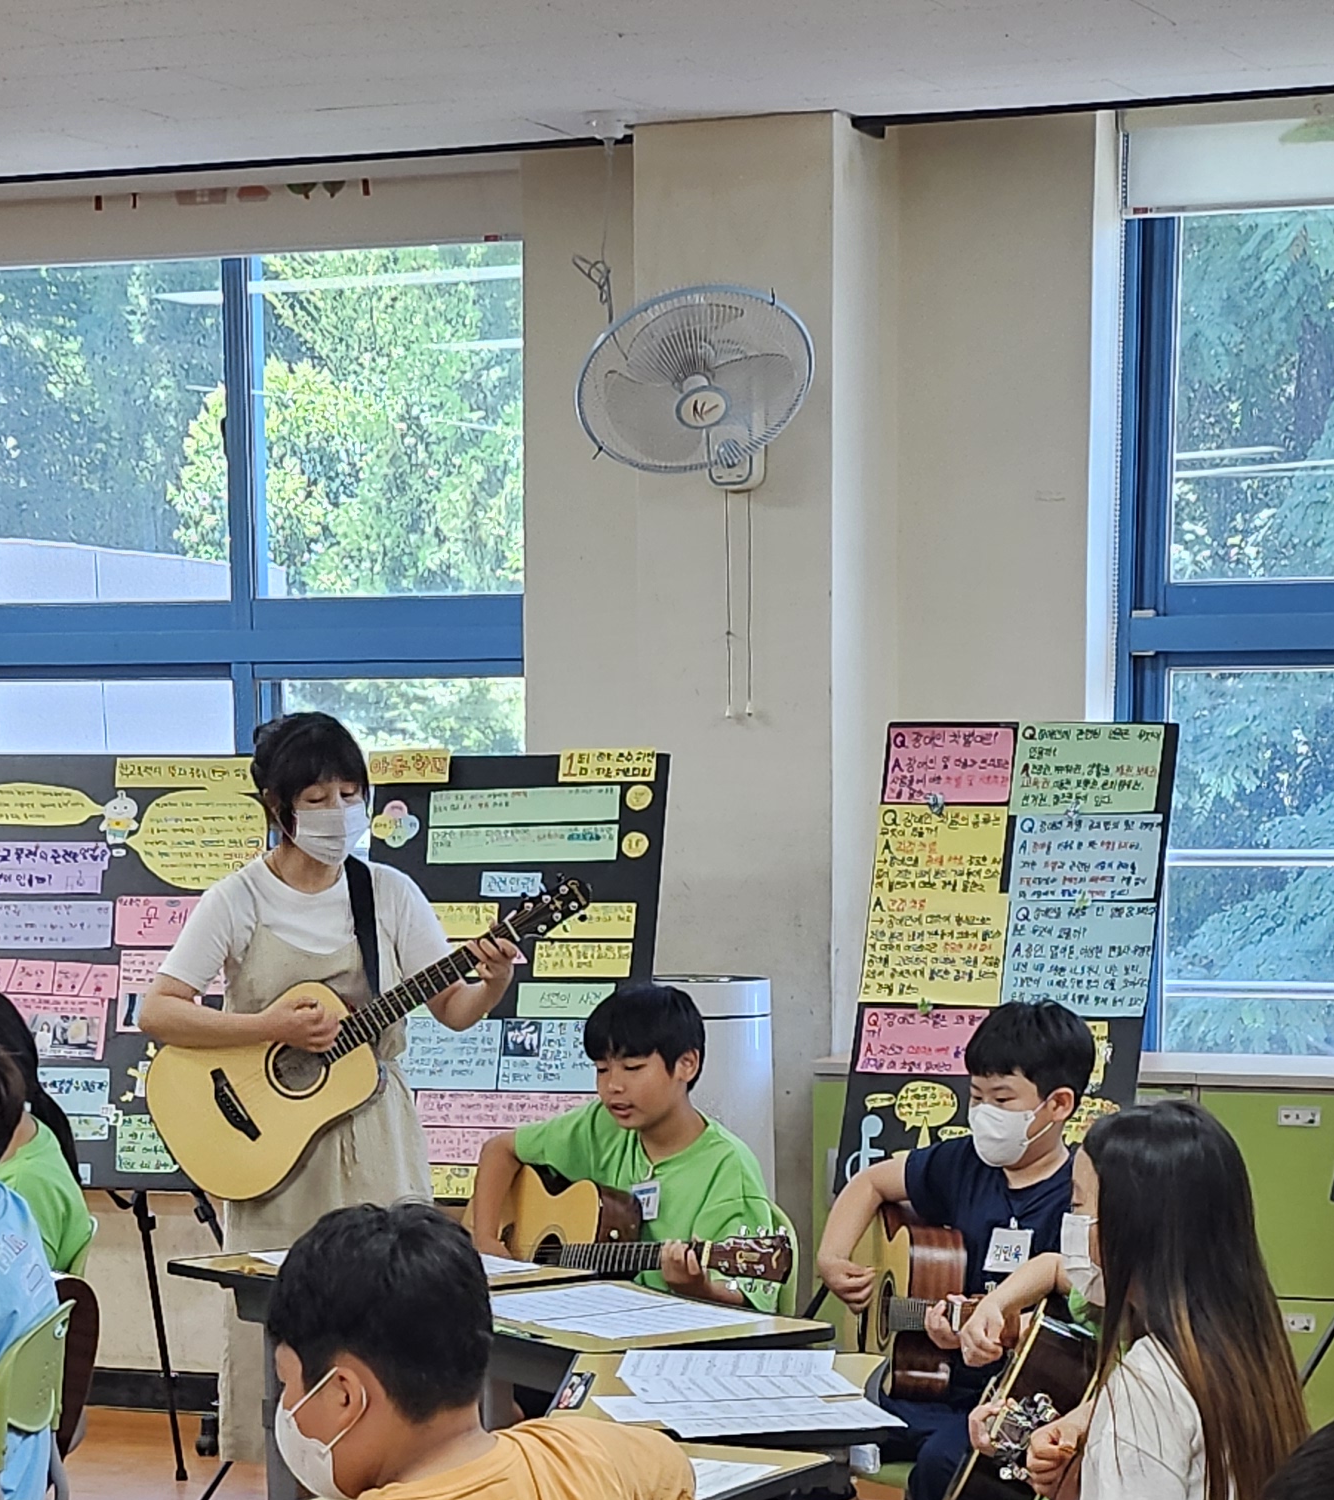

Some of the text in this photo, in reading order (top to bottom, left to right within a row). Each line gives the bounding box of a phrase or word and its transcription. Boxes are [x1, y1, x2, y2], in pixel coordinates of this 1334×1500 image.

[893, 731, 909, 750] Q
[1021, 724, 1037, 741] Q
[891, 757, 905, 774] A
[882, 808, 901, 827] Q
[880, 838, 894, 856] A
[872, 895, 886, 913] A
[1014, 906, 1031, 922] Q
[868, 1011, 880, 1028] Q
